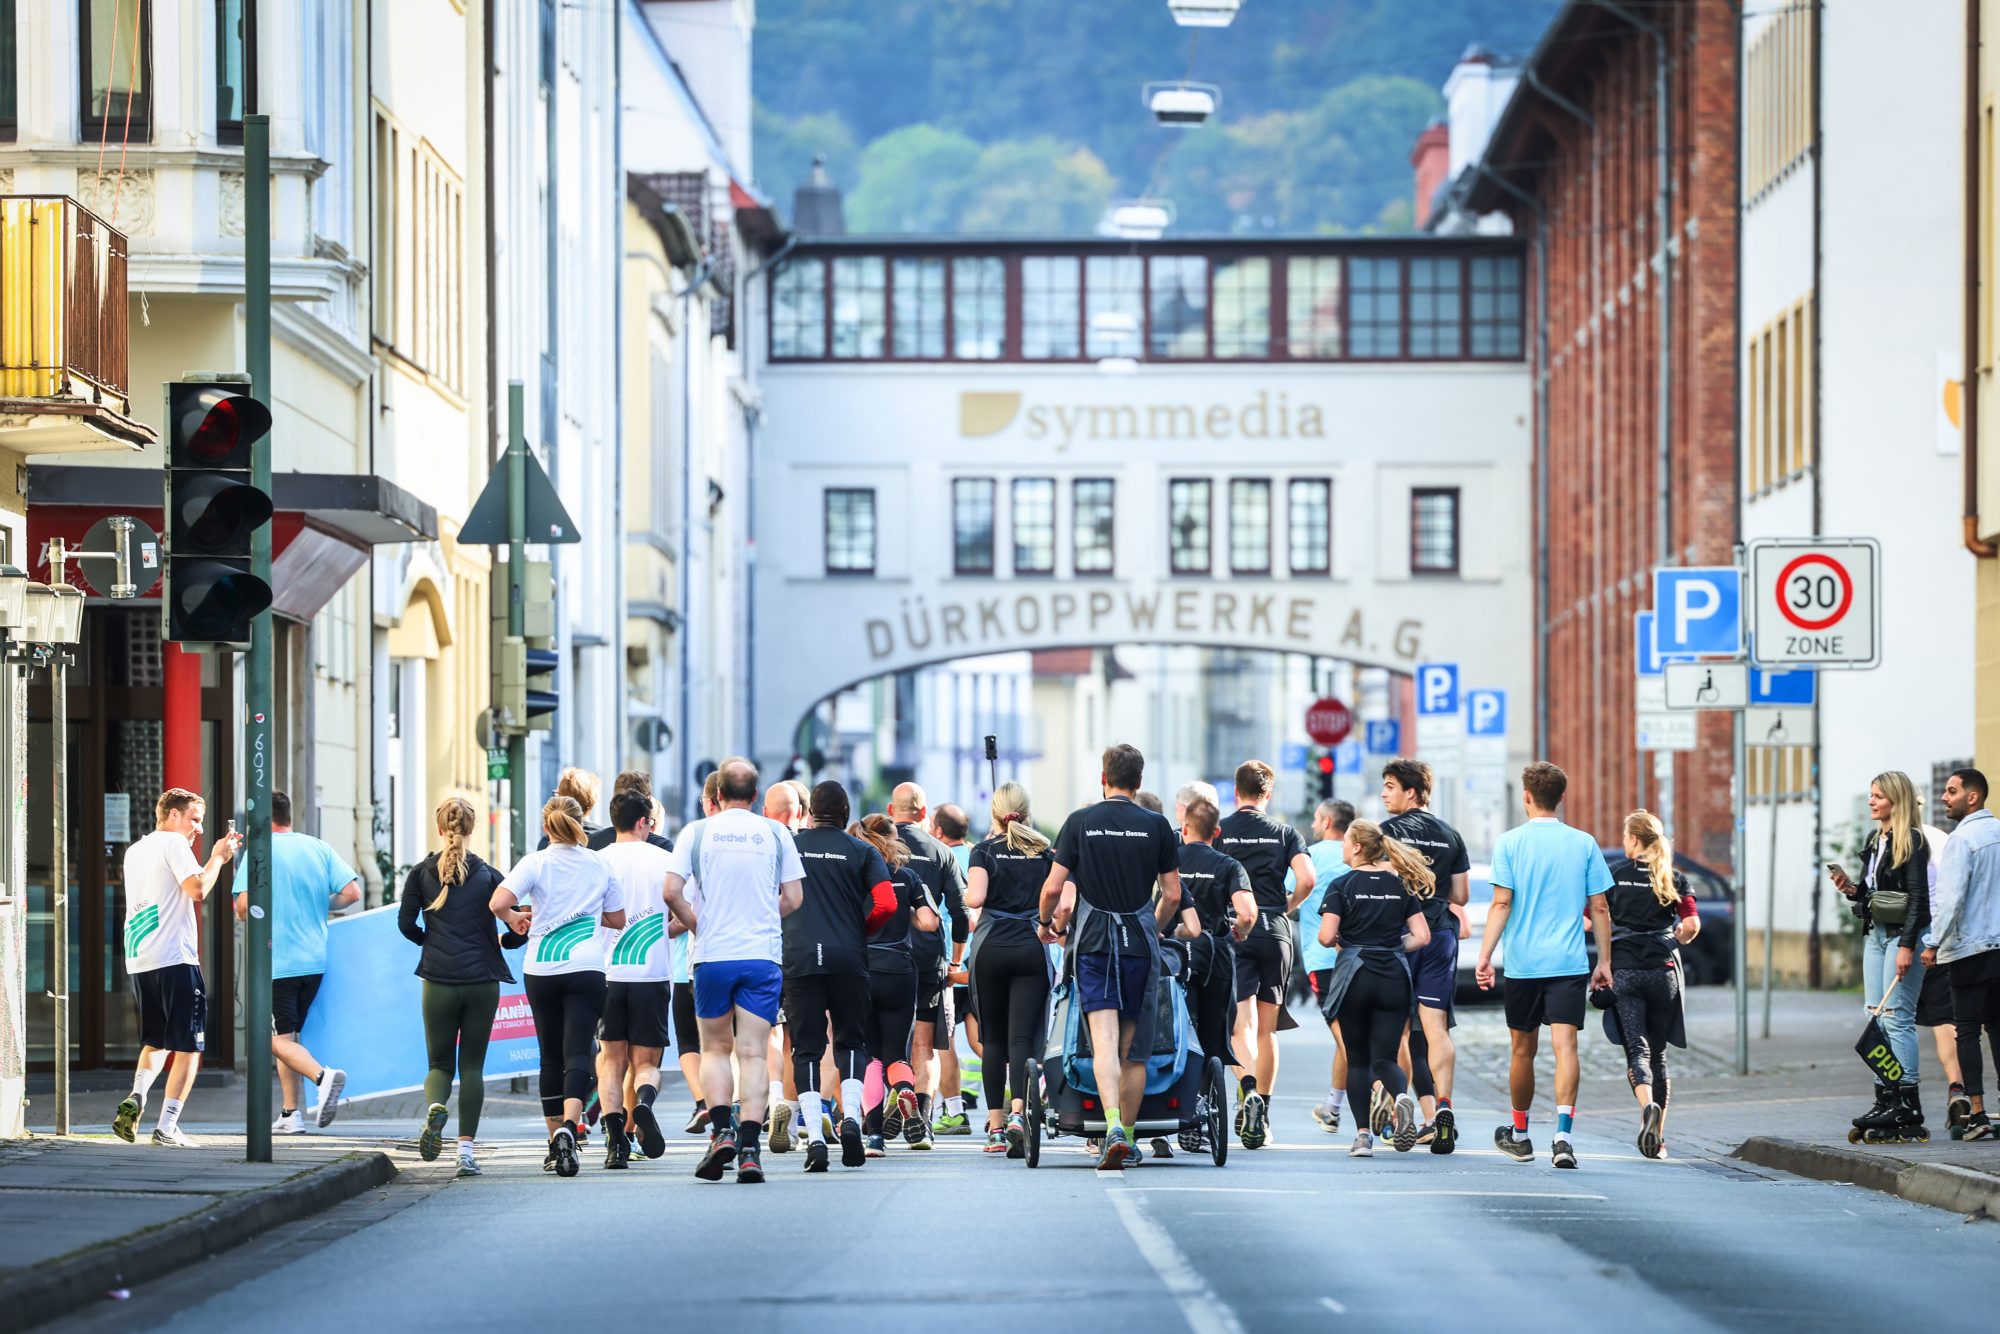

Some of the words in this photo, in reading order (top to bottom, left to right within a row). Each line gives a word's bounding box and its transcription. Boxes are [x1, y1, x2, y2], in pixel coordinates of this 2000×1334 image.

[1023, 388, 1328, 452] symmedia
[1791, 575, 1836, 609] 30
[864, 588, 1317, 662] DÜRKOPPWERKE
[1674, 579, 1722, 645] P
[1785, 636, 1844, 655] ZONE
[1424, 666, 1453, 712] P
[1308, 711, 1349, 735] STOP
[1472, 692, 1500, 733] P
[713, 833, 747, 843] Bethel
[1085, 829, 1104, 837] Miele.
[1105, 829, 1124, 837] Immer
[804, 851, 824, 859] Immer
